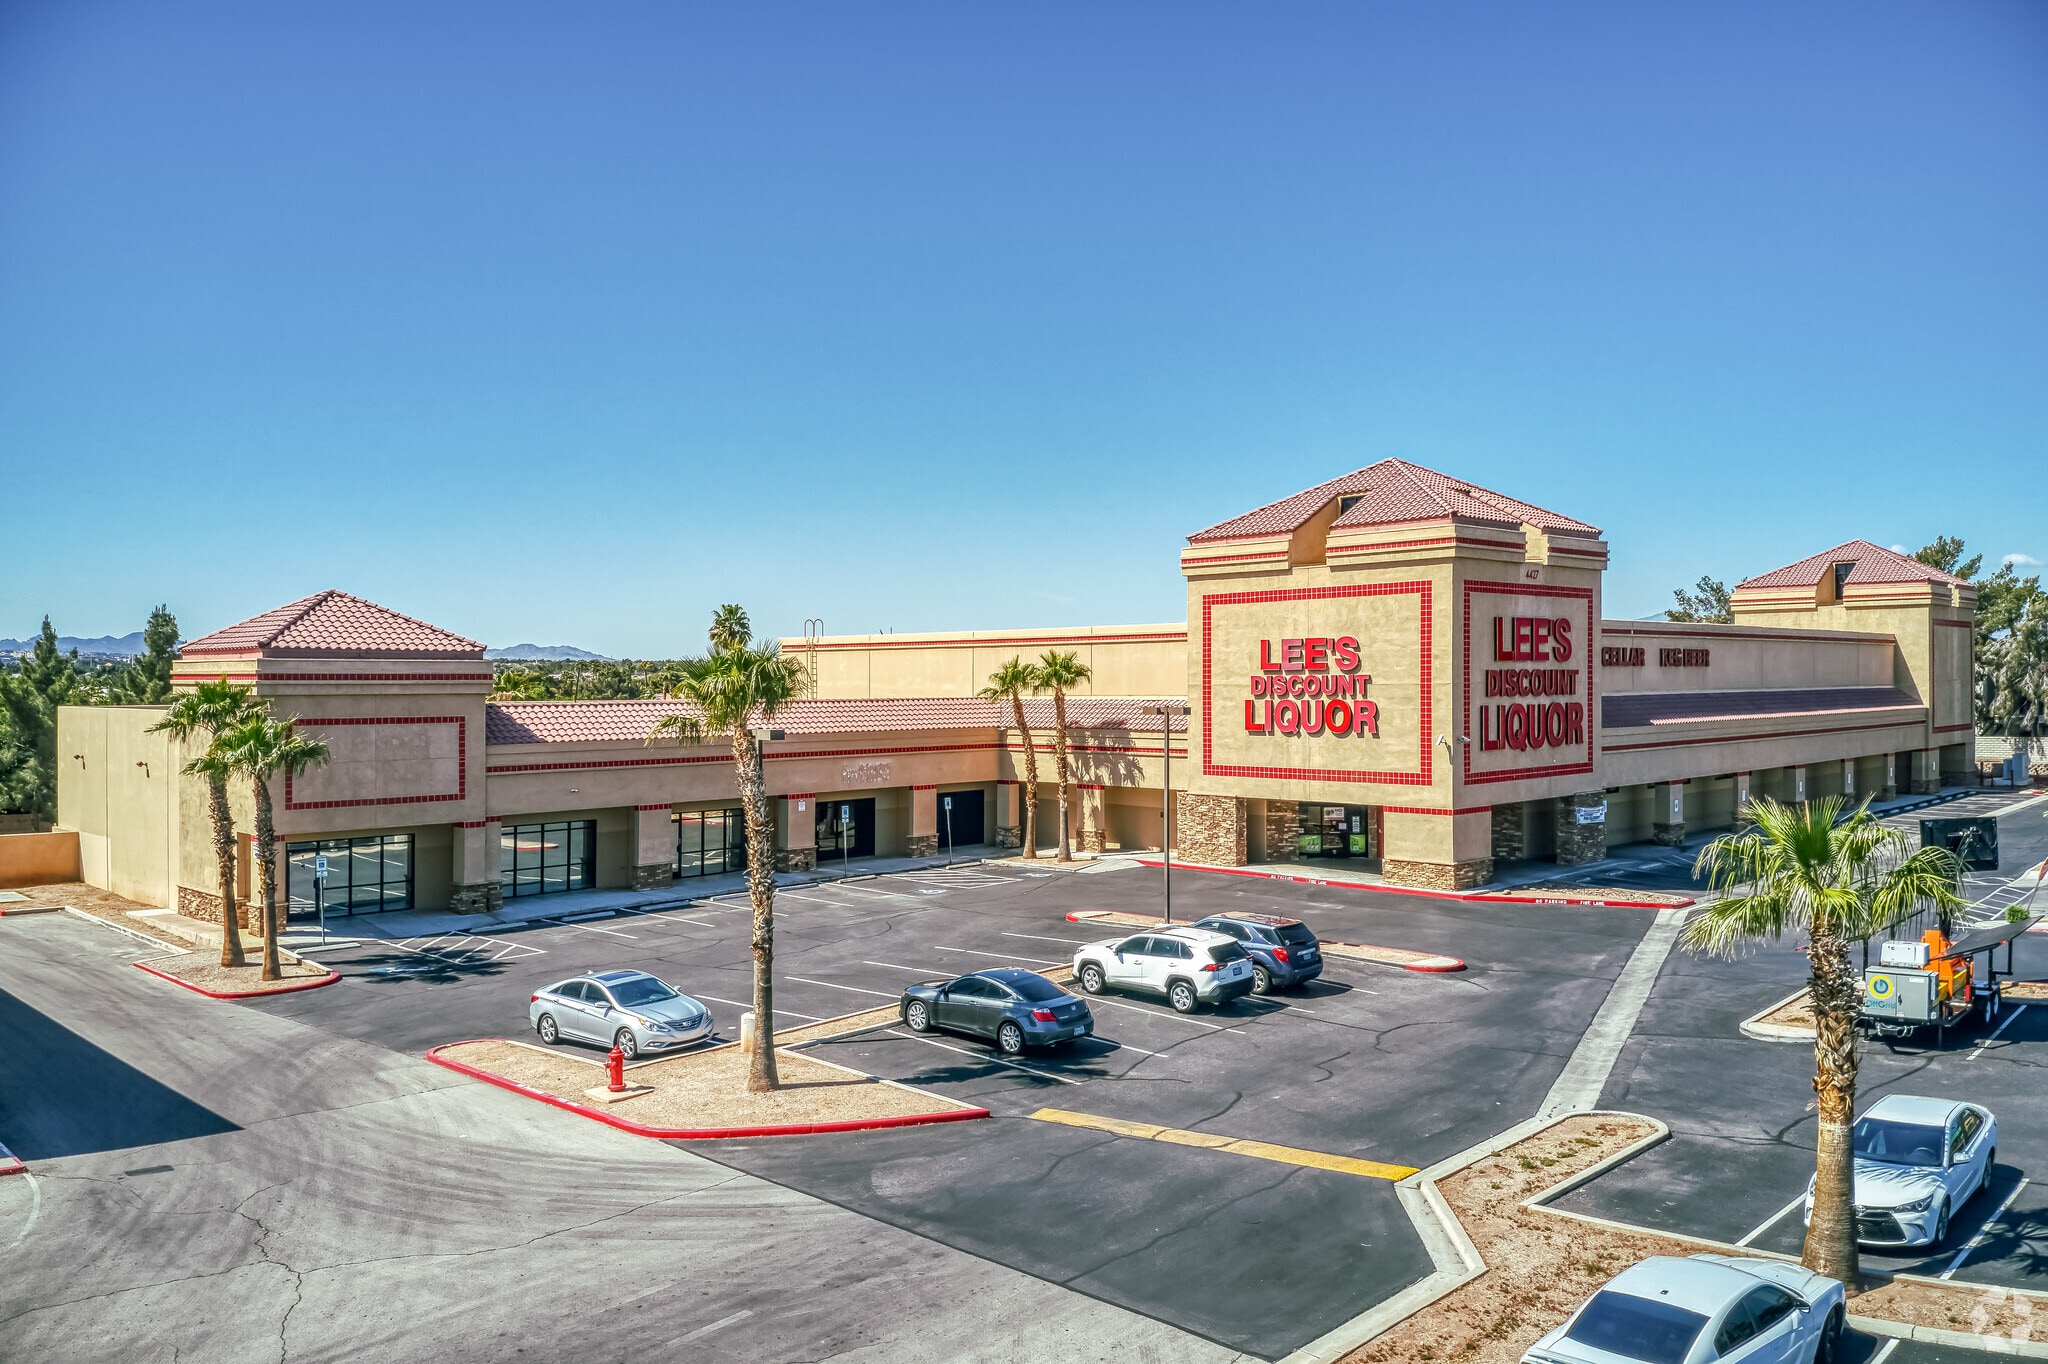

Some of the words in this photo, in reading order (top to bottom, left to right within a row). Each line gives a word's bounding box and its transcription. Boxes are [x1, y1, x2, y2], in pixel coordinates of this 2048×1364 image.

[1525, 569, 1539, 580] 4427
[1260, 636, 1361, 672] LEE'S
[1494, 616, 1573, 663] LEE'S
[1601, 646, 1646, 667] CELLAR
[1659, 647, 1682, 667] KEG
[1683, 648, 1710, 667] BEER
[1250, 674, 1372, 697] DISCOUNT
[1485, 669, 1580, 698] DISCOUNT
[1244, 699, 1379, 736] LIQUOR
[1480, 702, 1584, 752] LIQUOR
